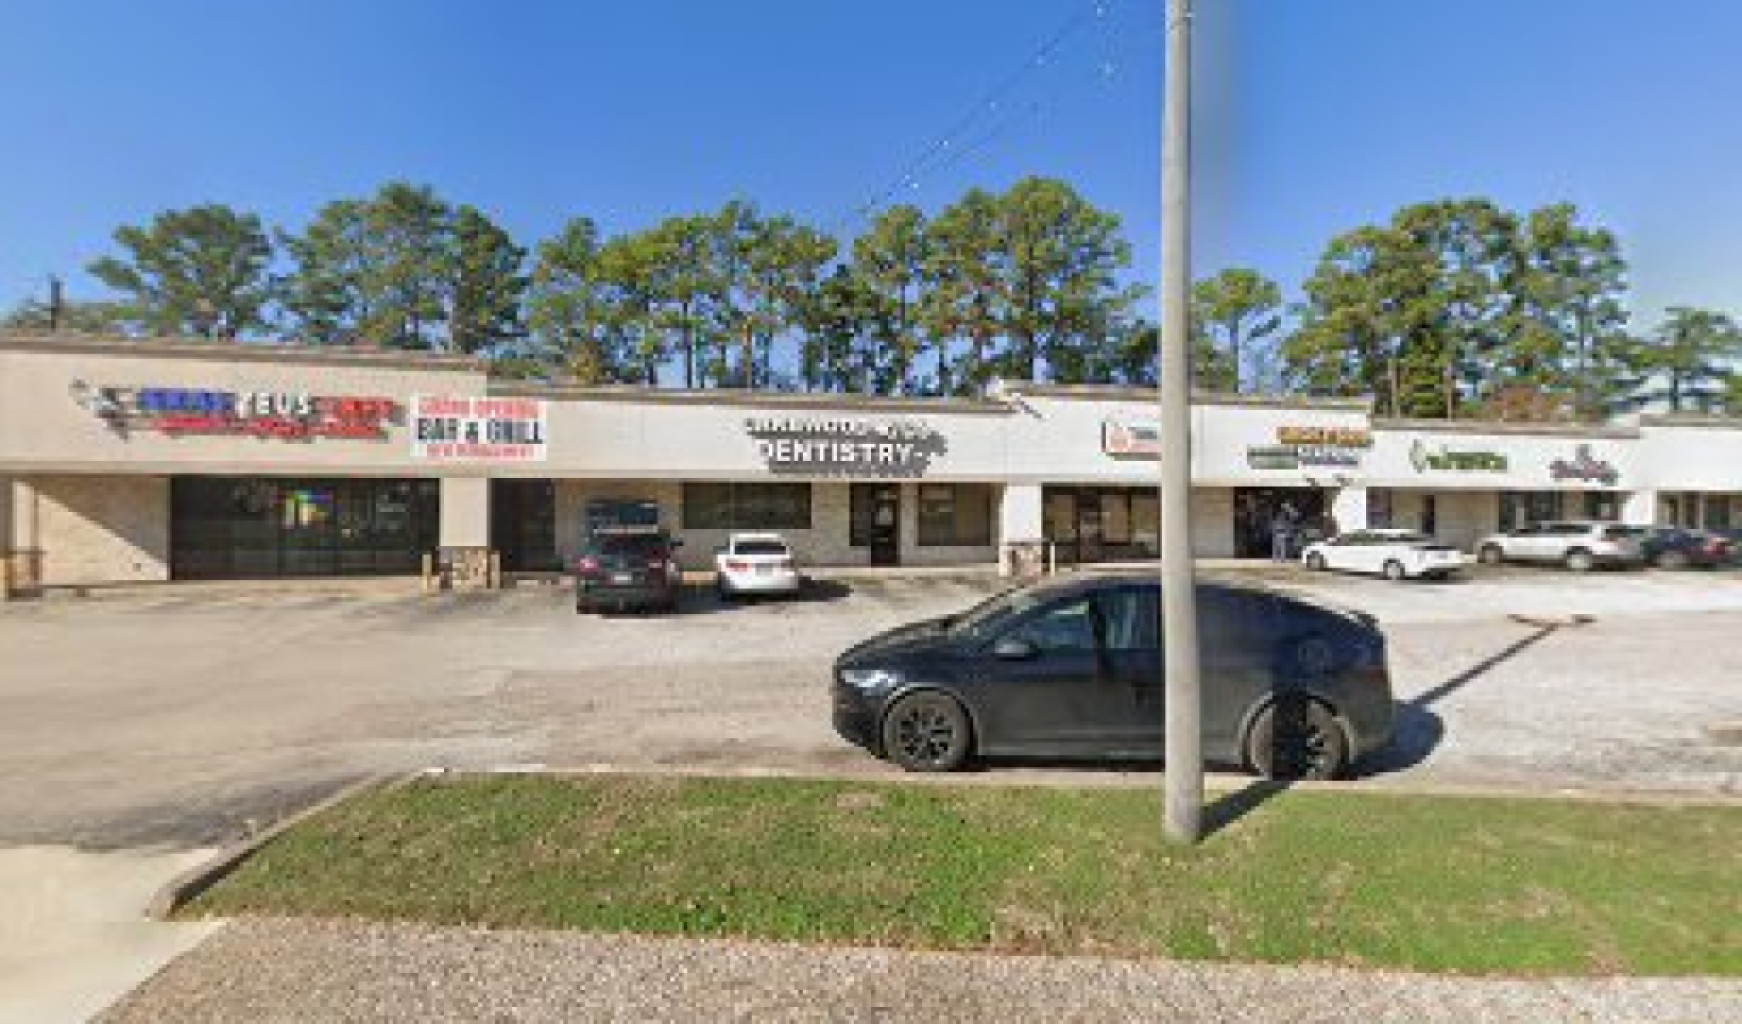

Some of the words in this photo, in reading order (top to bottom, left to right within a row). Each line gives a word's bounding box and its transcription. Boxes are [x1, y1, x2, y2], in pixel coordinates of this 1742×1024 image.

[417, 418, 457, 440] BAR
[486, 420, 543, 444] GRILL
[754, 440, 914, 463] DENTISTRY
